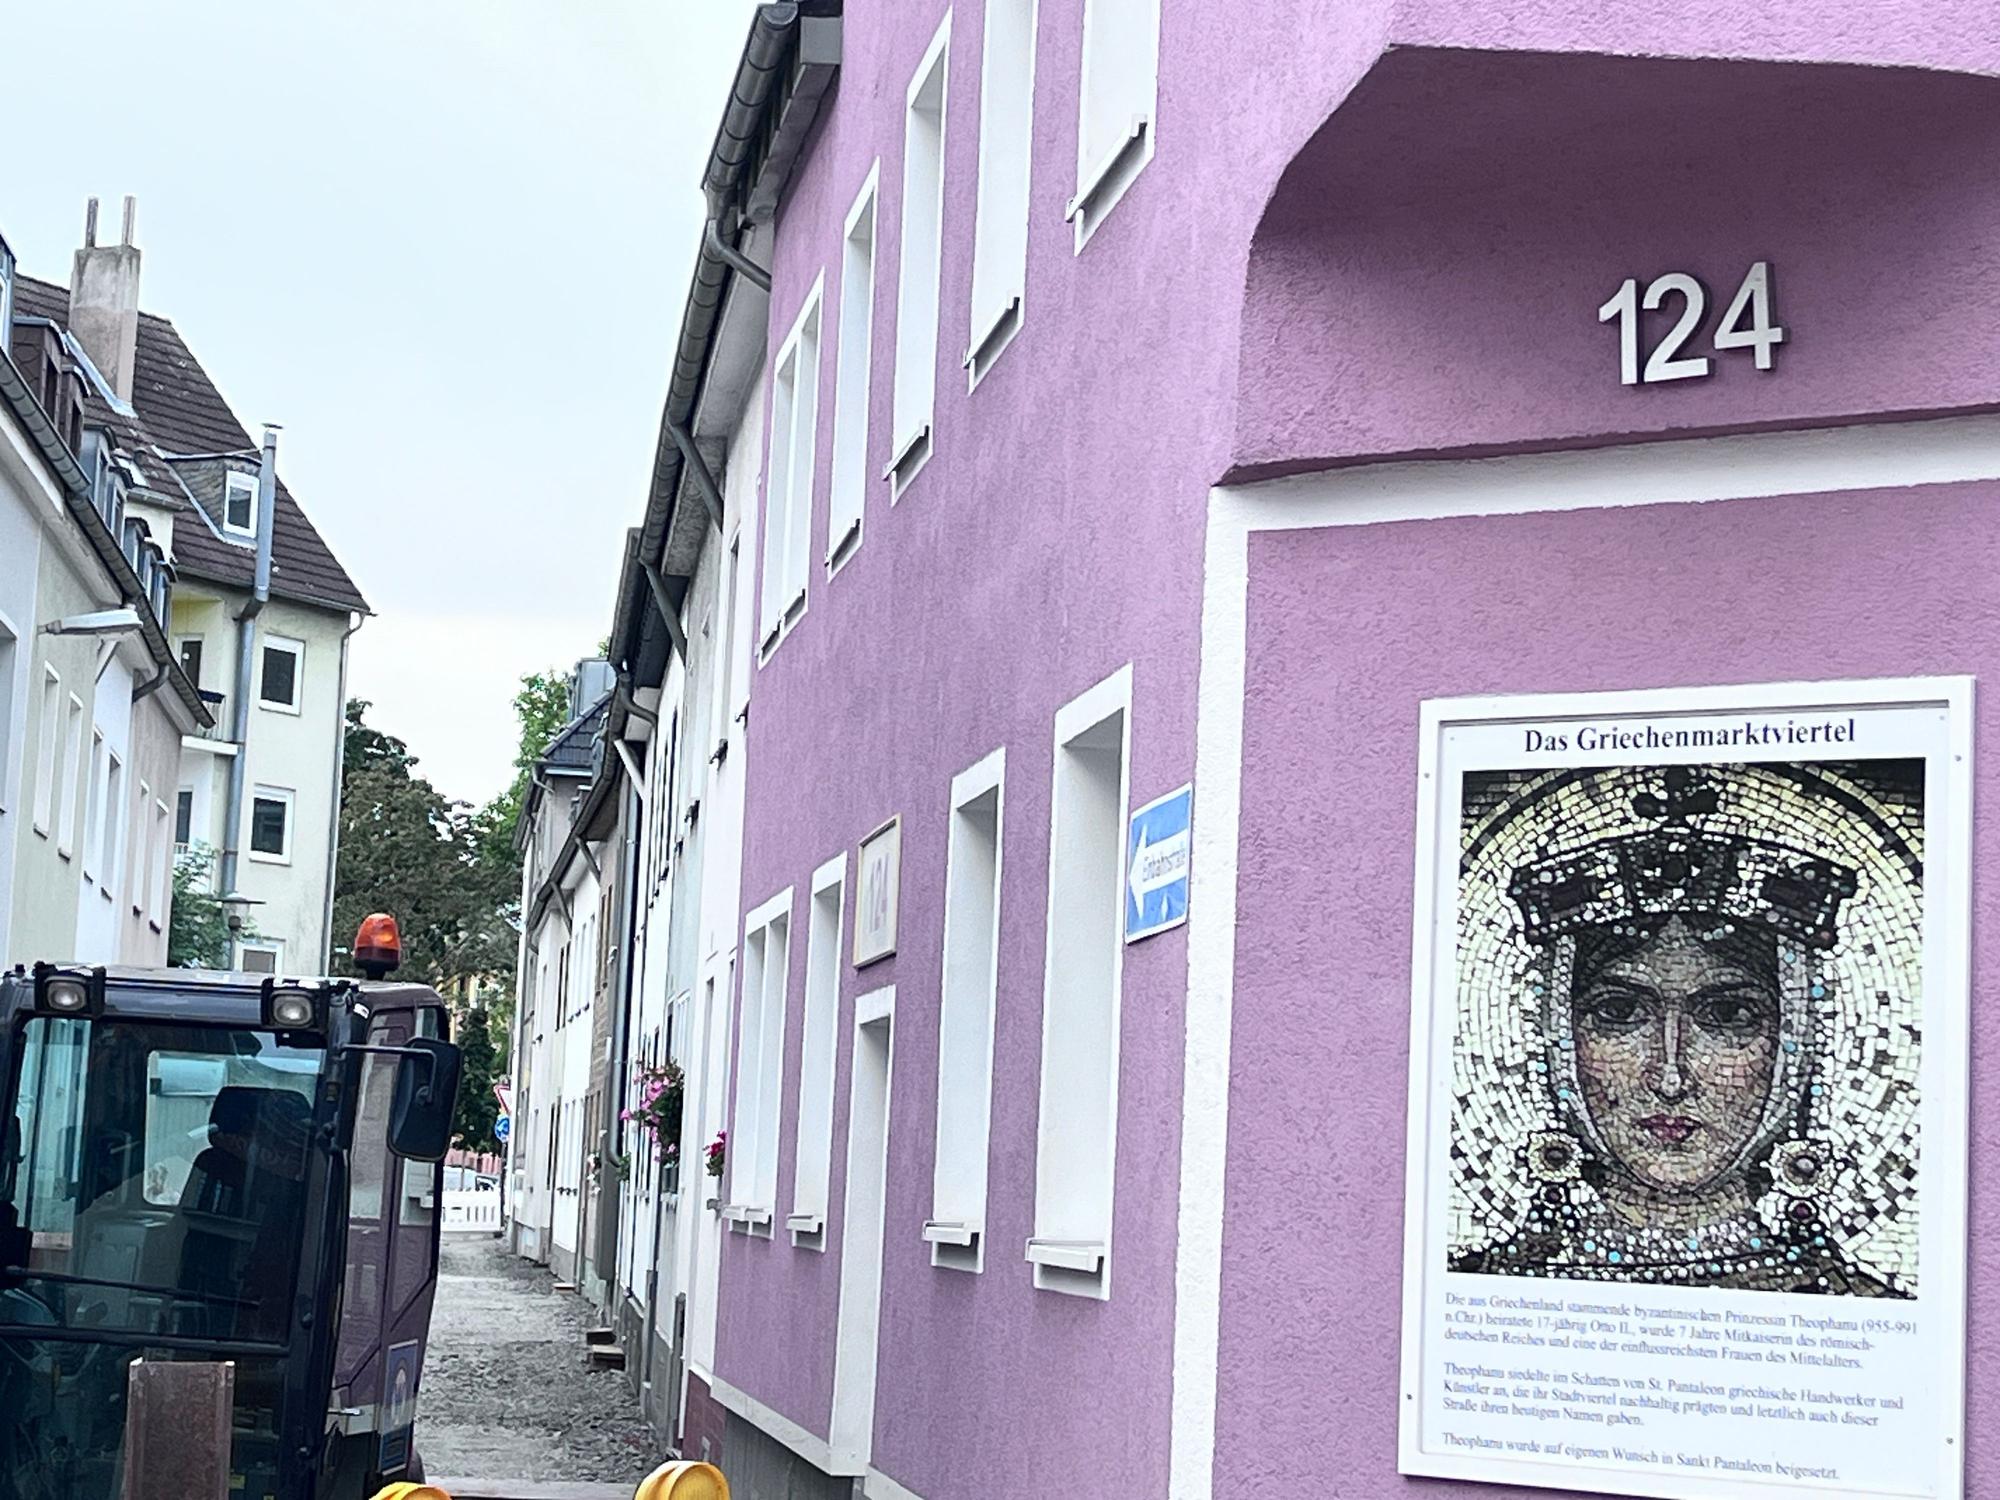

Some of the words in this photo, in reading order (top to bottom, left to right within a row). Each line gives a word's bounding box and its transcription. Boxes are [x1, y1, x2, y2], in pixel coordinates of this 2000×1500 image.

[1599, 262, 1782, 384] 124
[1525, 730, 1568, 752] Das
[1577, 719, 1854, 751] Griechenmarktviertel
[1445, 1292, 1466, 1305] Die
[1468, 1298, 1487, 1307] aus
[1489, 1295, 1564, 1312] Griechenland
[1567, 1300, 1631, 1316] stammende
[1634, 1305, 1721, 1321] byzantinischen
[1725, 1310, 1786, 1326] Prinzessin
[1790, 1314, 1858, 1330] Theophanu
[1444, 1327, 1499, 1343] deutschen
[1502, 1331, 1546, 1346] Reiches
[1548, 1335, 1570, 1348] und
[1572, 1340, 1597, 1350] eine
[1599, 1338, 1619, 1351] der
[1721, 1347, 1763, 1361] Frauen
[1766, 1350, 1786, 1363] des
[1590, 1320, 1616, 1333] Otto
[1639, 1324, 1675, 1337] wurde
[1679, 1326, 1686, 1335] 7
[1689, 1326, 1721, 1341] Jahre
[1724, 1329, 1793, 1345] Mitkaiserin
[1796, 1334, 1817, 1347] des
[1444, 1362, 1505, 1379] Theophanu
[1507, 1367, 1550, 1382] siedelte
[1553, 1374, 1568, 1384] im
[1571, 1372, 1621, 1388] Schatten
[1623, 1379, 1645, 1389] von
[1668, 1379, 1726, 1396] Pantaleon
[1729, 1384, 1797, 1401] griechische
[1801, 1389, 1876, 1407] Handwerker
[1880, 1395, 1904, 1409] und
[1443, 1397, 1478, 1412] Straße
[1481, 1400, 1509, 1414] ihren
[1511, 1403, 1560, 1420] heutigen
[1562, 1408, 1604, 1422] Namen
[1512, 1386, 1530, 1398] die
[1533, 1387, 1548, 1400] ihr
[1551, 1388, 1617, 1405] Stadtviertel
[1619, 1394, 1680, 1411] nachhaltig
[1683, 1400, 1727, 1417] prägten
[1730, 1402, 1753, 1417] und
[1757, 1404, 1805, 1421] letztlich
[1809, 1409, 1838, 1423] auch
[1841, 1411, 1879, 1426] dieser
[1442, 1432, 1503, 1450] Theophanu
[1506, 1438, 1541, 1453] wurde
[1544, 1442, 1564, 1455] auf
[1565, 1446, 1609, 1459] eigenen
[1612, 1447, 1659, 1463] Wunsch
[1662, 1455, 1673, 1464] in
[1677, 1453, 1710, 1468] Sankt
[1714, 1456, 1772, 1473] Pantaleon
